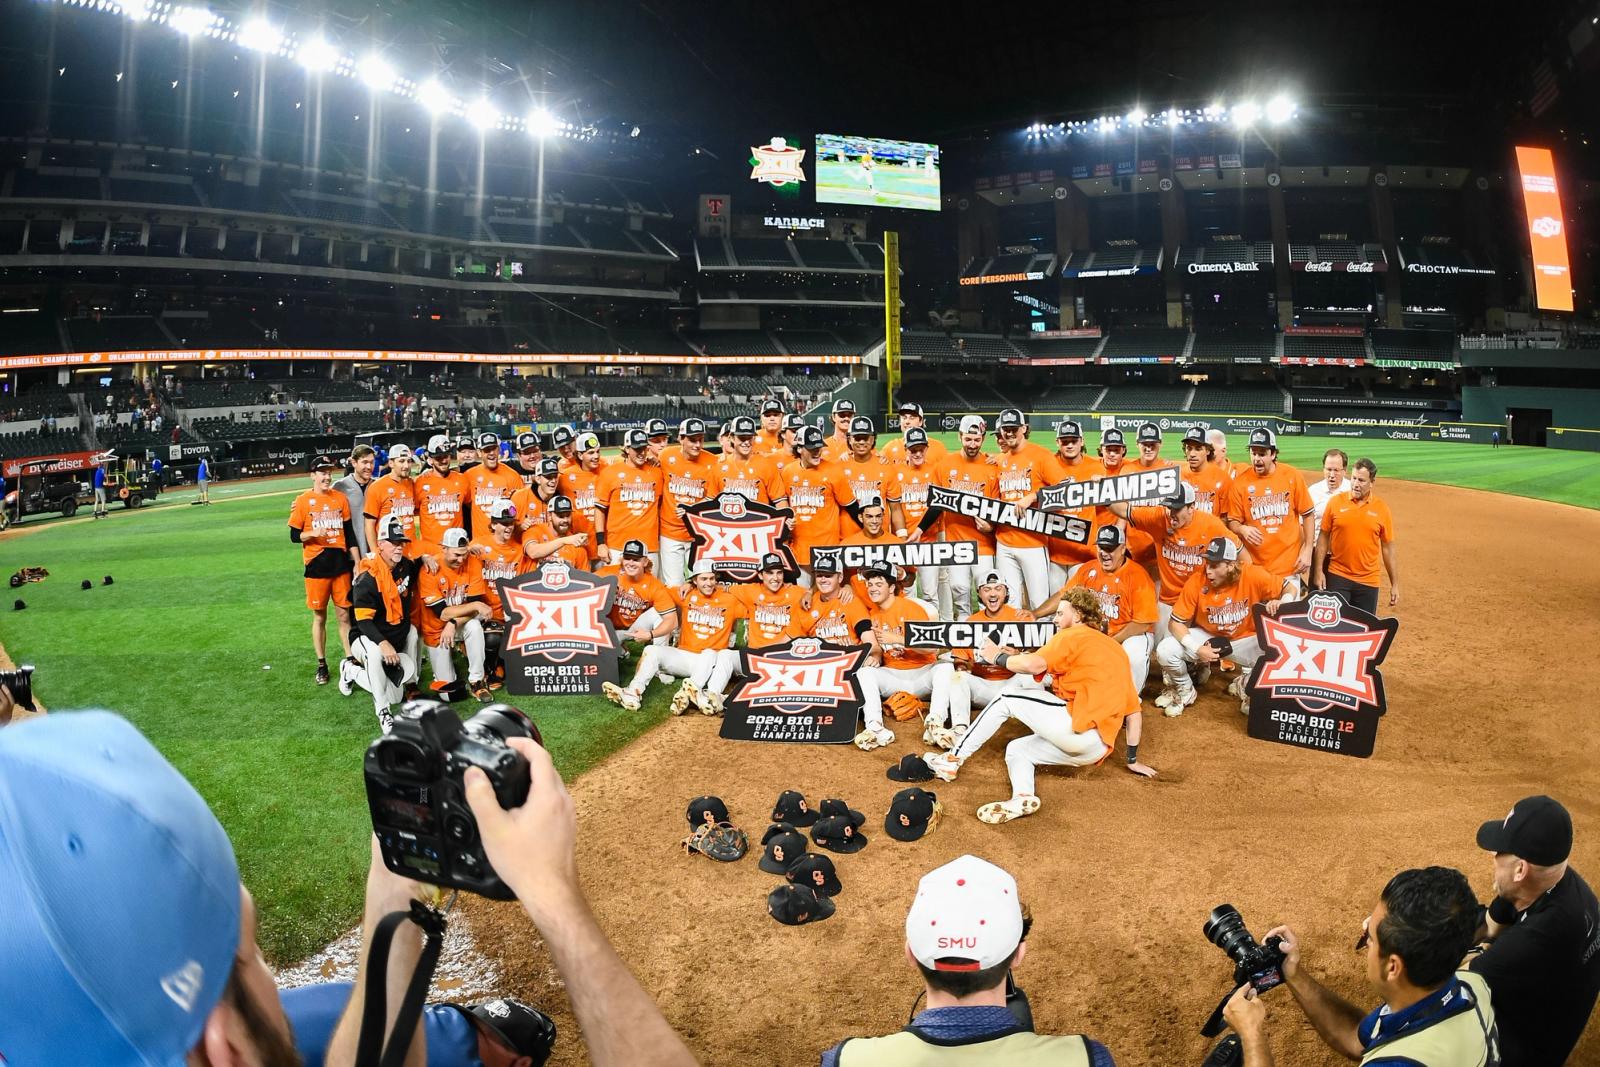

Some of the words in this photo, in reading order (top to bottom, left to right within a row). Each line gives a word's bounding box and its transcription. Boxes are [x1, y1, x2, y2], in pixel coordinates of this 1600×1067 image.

[1271, 175, 1277, 184] 7
[763, 216, 825, 229] KARBACH
[1234, 262, 1260, 272] Bank
[1412, 263, 1459, 274] CHOCTAW
[959, 277, 980, 286] CORE
[981, 272, 1028, 284] PERSONNEL
[1077, 270, 1108, 278] LOCKHEED
[1108, 269, 1131, 277] MARTIN
[8, 358, 41, 366] BASEBALL
[43, 355, 84, 364] CHAMPIONS
[147, 352, 167, 360] STATE
[1382, 360, 1411, 368] LUXOR
[1411, 360, 1453, 370] STAFFING
[600, 418, 648, 429] Germania
[1170, 420, 1198, 428] Medical
[1197, 421, 1211, 430] City
[1230, 418, 1269, 427] CHOCTAW
[1379, 418, 1415, 426] MARTIN
[182, 446, 211, 455] TOYOTA
[1067, 469, 1177, 507] CHAMPS
[723, 504, 741, 513] 66
[960, 495, 1087, 542] CHAMPS
[696, 522, 777, 560] XII
[844, 542, 974, 568] CHAMPS
[1162, 546, 1203, 566] CHAMPIONS
[546, 573, 565, 584] 66
[1314, 600, 1336, 608] PHILLIPS
[514, 594, 602, 641] XII
[1208, 606, 1250, 625] CHAMPIONS
[1314, 608, 1334, 621] 66
[911, 628, 943, 643] XII
[528, 642, 590, 651] CHAMPIONSHIP
[796, 646, 815, 654] 66
[1267, 629, 1374, 694] XII
[524, 665, 555, 676] 2024
[557, 665, 581, 676] BIG
[583, 665, 598, 676] 12
[534, 676, 590, 685] BASEBALL
[748, 659, 850, 695] XII
[534, 684, 591, 693] CHAMPIONS
[1280, 687, 1352, 703] CHAMPIONSHIP
[746, 715, 784, 725] 2024
[786, 715, 814, 726] BIG
[816, 716, 834, 726] 12
[1270, 710, 1306, 725] 2024
[1309, 717, 1335, 731] BIG
[1337, 720, 1355, 733] 12
[755, 724, 821, 733] BASEBALL
[1279, 723, 1342, 741] BASEBALL
[753, 731, 821, 741] CHAMPIONS
[1278, 731, 1341, 750] CHAMPIONS
[937, 936, 977, 949] SMU
